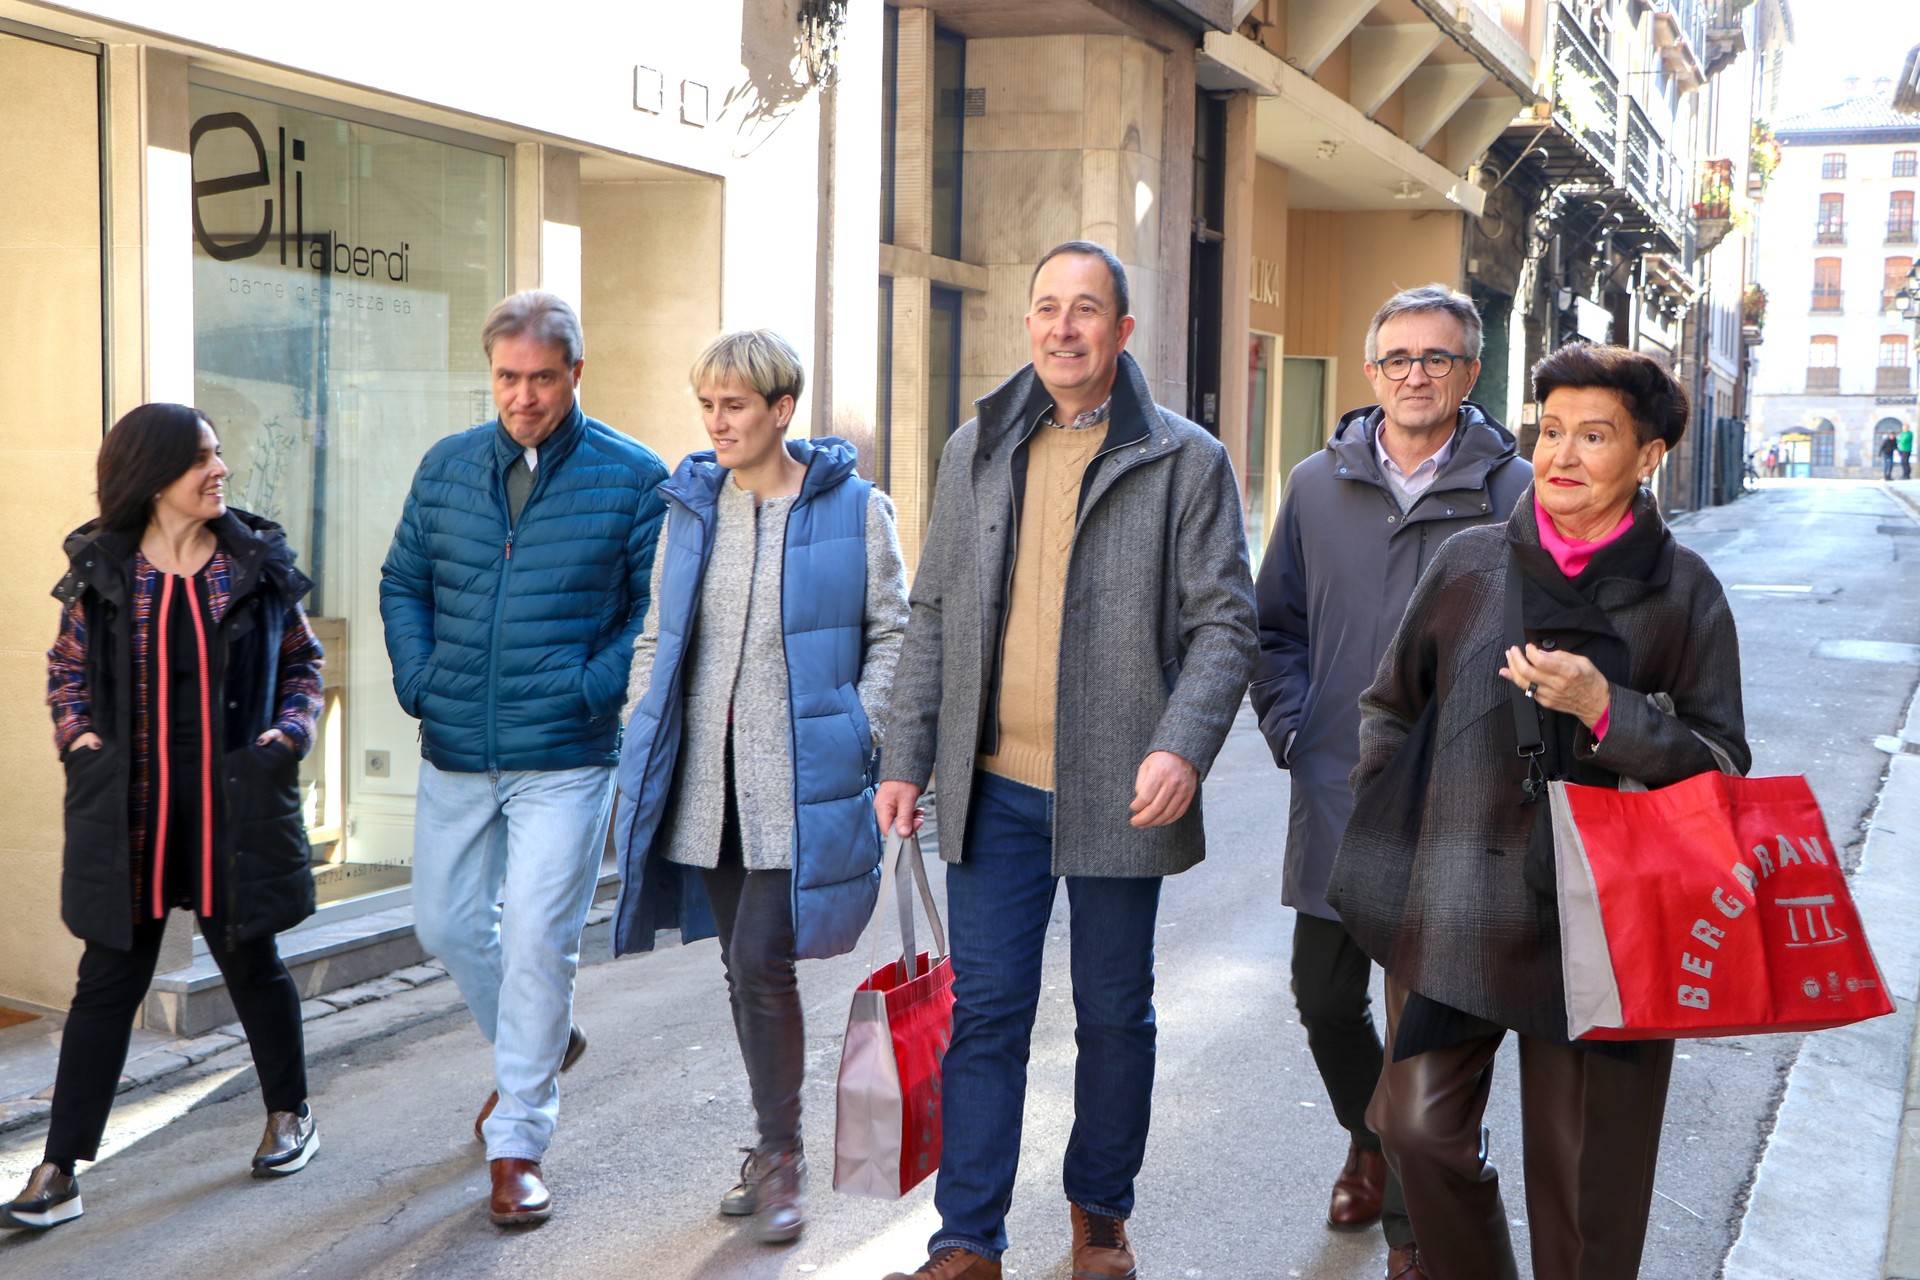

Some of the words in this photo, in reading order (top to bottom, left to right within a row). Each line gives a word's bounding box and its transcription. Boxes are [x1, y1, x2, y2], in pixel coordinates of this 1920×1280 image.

[189, 111, 306, 269] eli
[308, 229, 411, 284] alberdi
[1677, 832, 1829, 1010] BERGARAN
